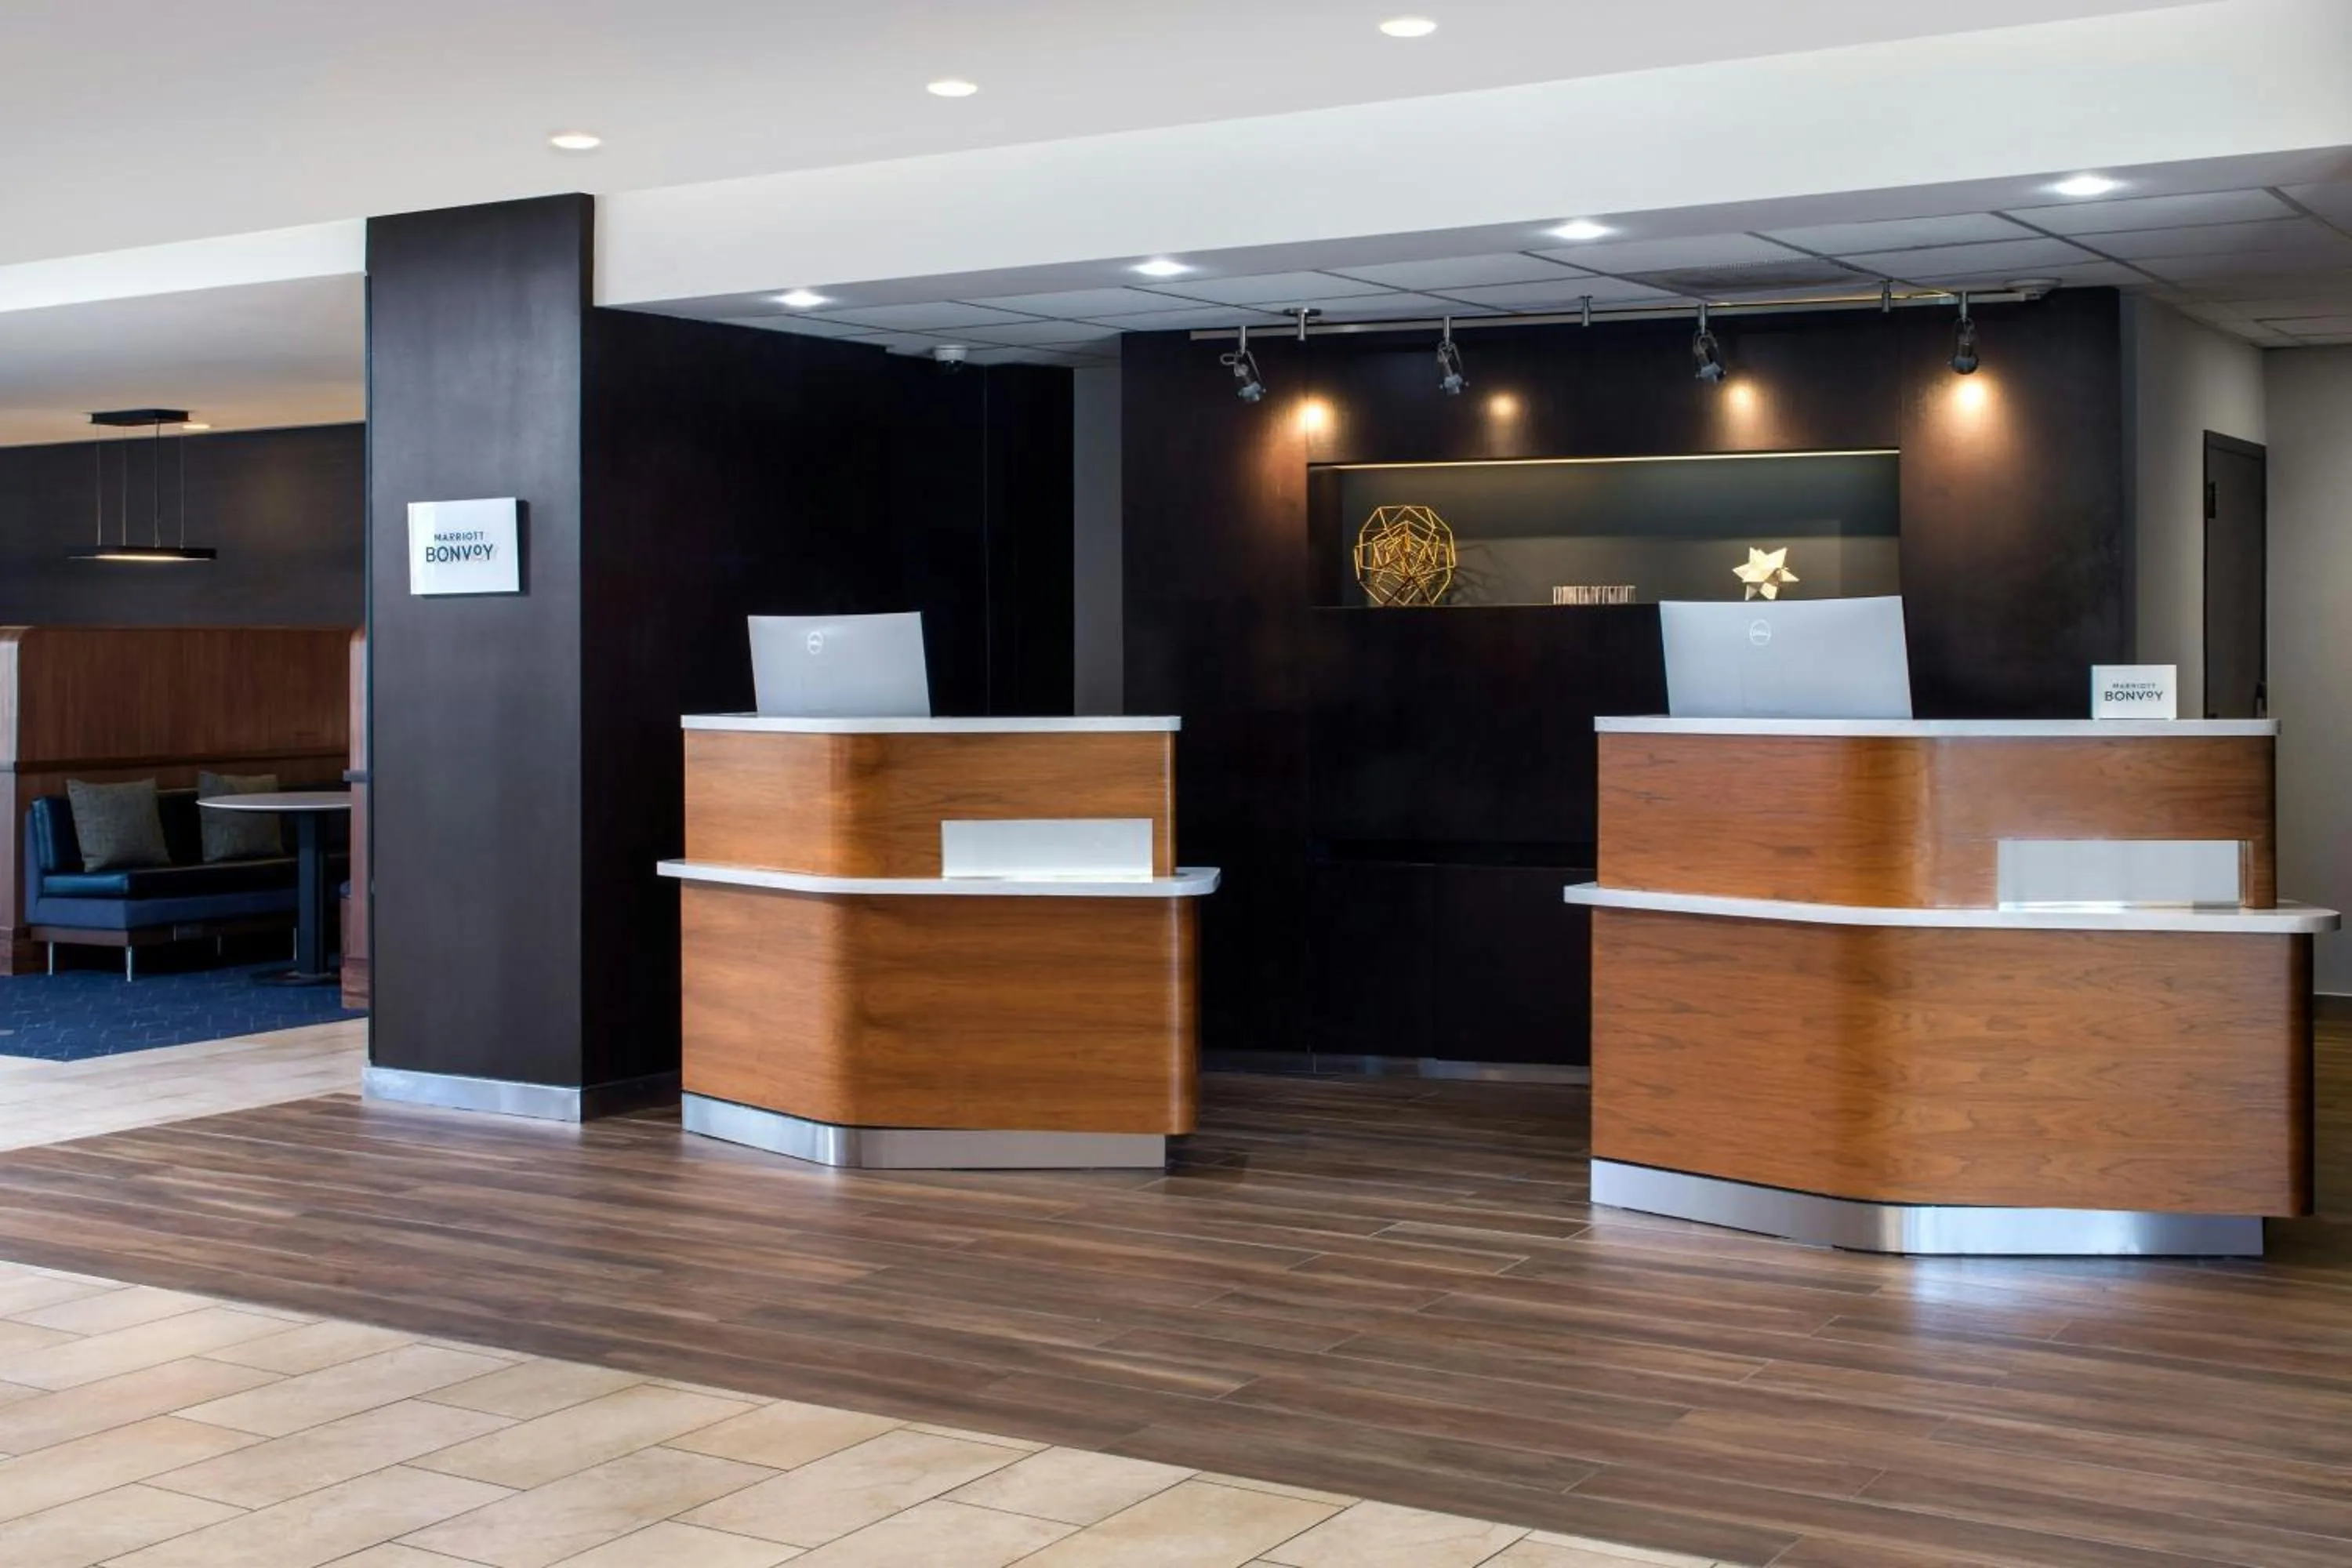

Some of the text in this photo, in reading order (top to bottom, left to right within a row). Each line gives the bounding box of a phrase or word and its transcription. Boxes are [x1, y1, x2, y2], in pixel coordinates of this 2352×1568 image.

[434, 531, 484, 542] MARRIOTT
[426, 543, 493, 562] BONVOY
[2104, 690, 2164, 702] BONVOY
